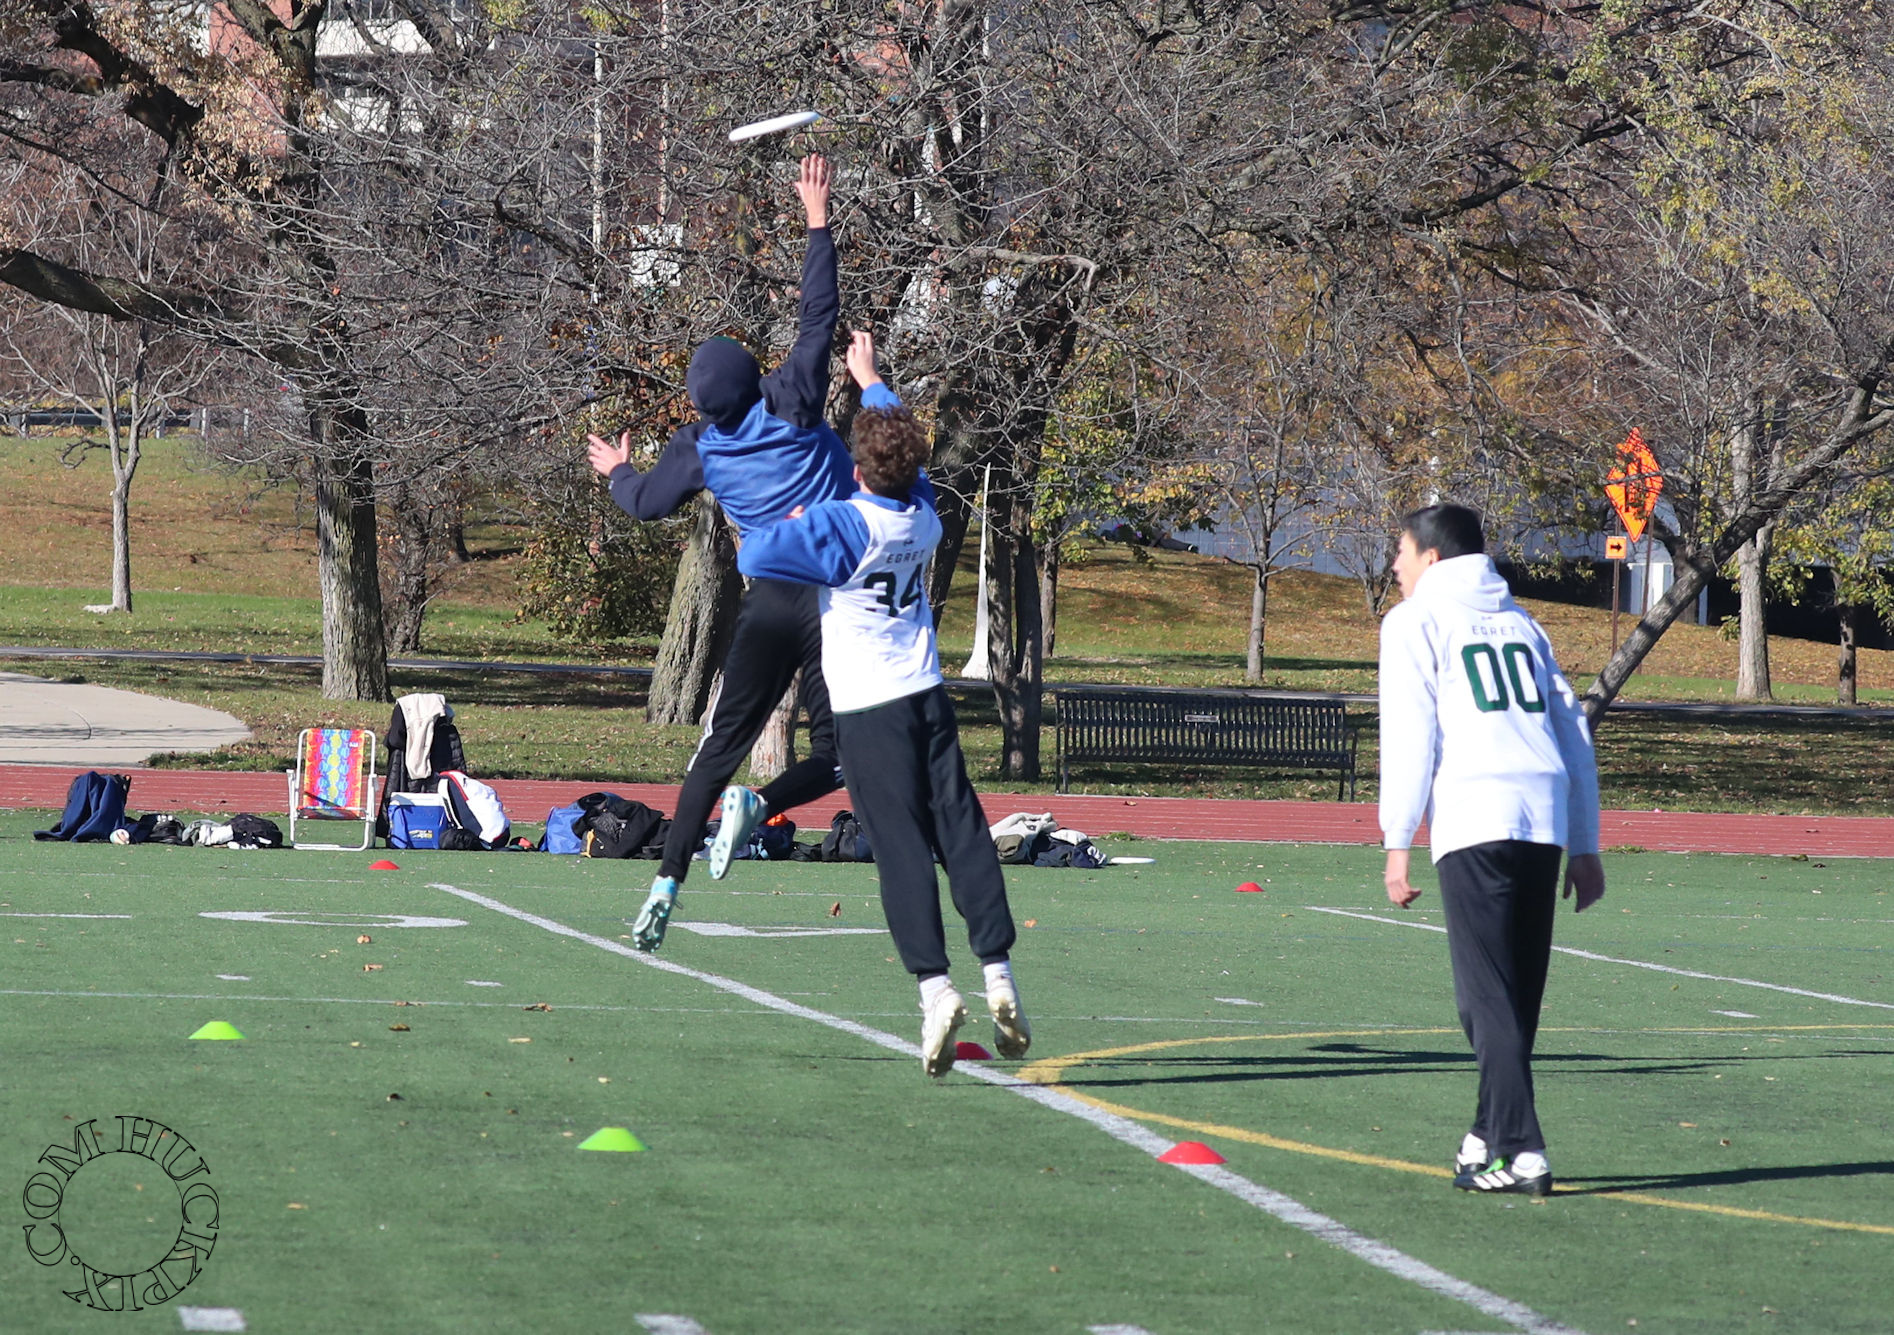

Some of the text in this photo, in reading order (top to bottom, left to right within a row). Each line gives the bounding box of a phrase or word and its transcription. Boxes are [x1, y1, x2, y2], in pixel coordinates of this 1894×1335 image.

[886, 549, 925, 563] EGRET
[1472, 625, 1516, 636] EGRET
[1461, 642, 1546, 713] 00
